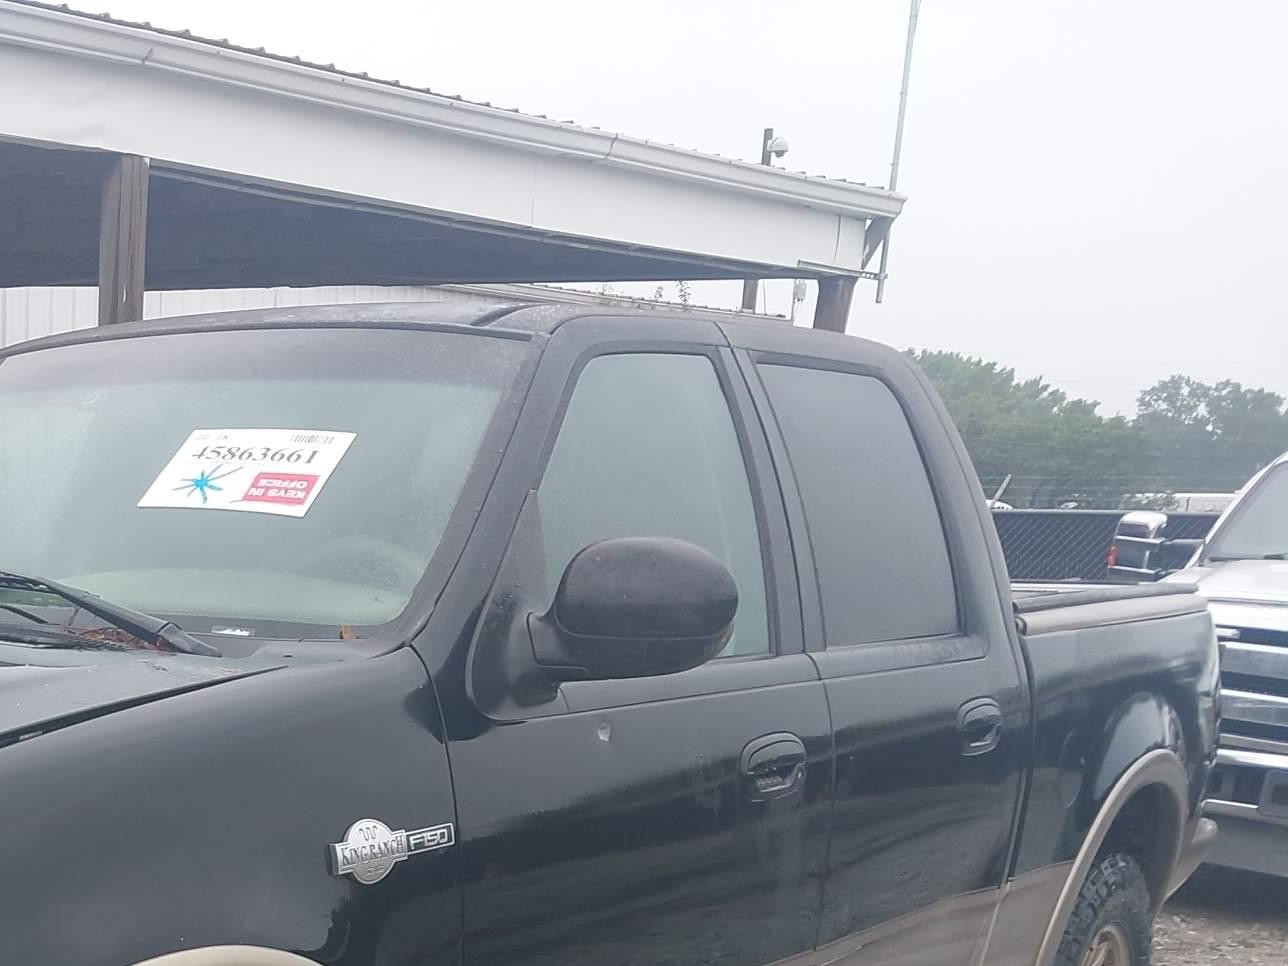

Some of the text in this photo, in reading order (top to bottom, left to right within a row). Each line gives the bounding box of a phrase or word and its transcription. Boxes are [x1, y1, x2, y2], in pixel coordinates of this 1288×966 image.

[192, 444, 320, 465] 45863661
[257, 478, 309, 489] OFFICE
[248, 486, 307, 499] KEYS IN
